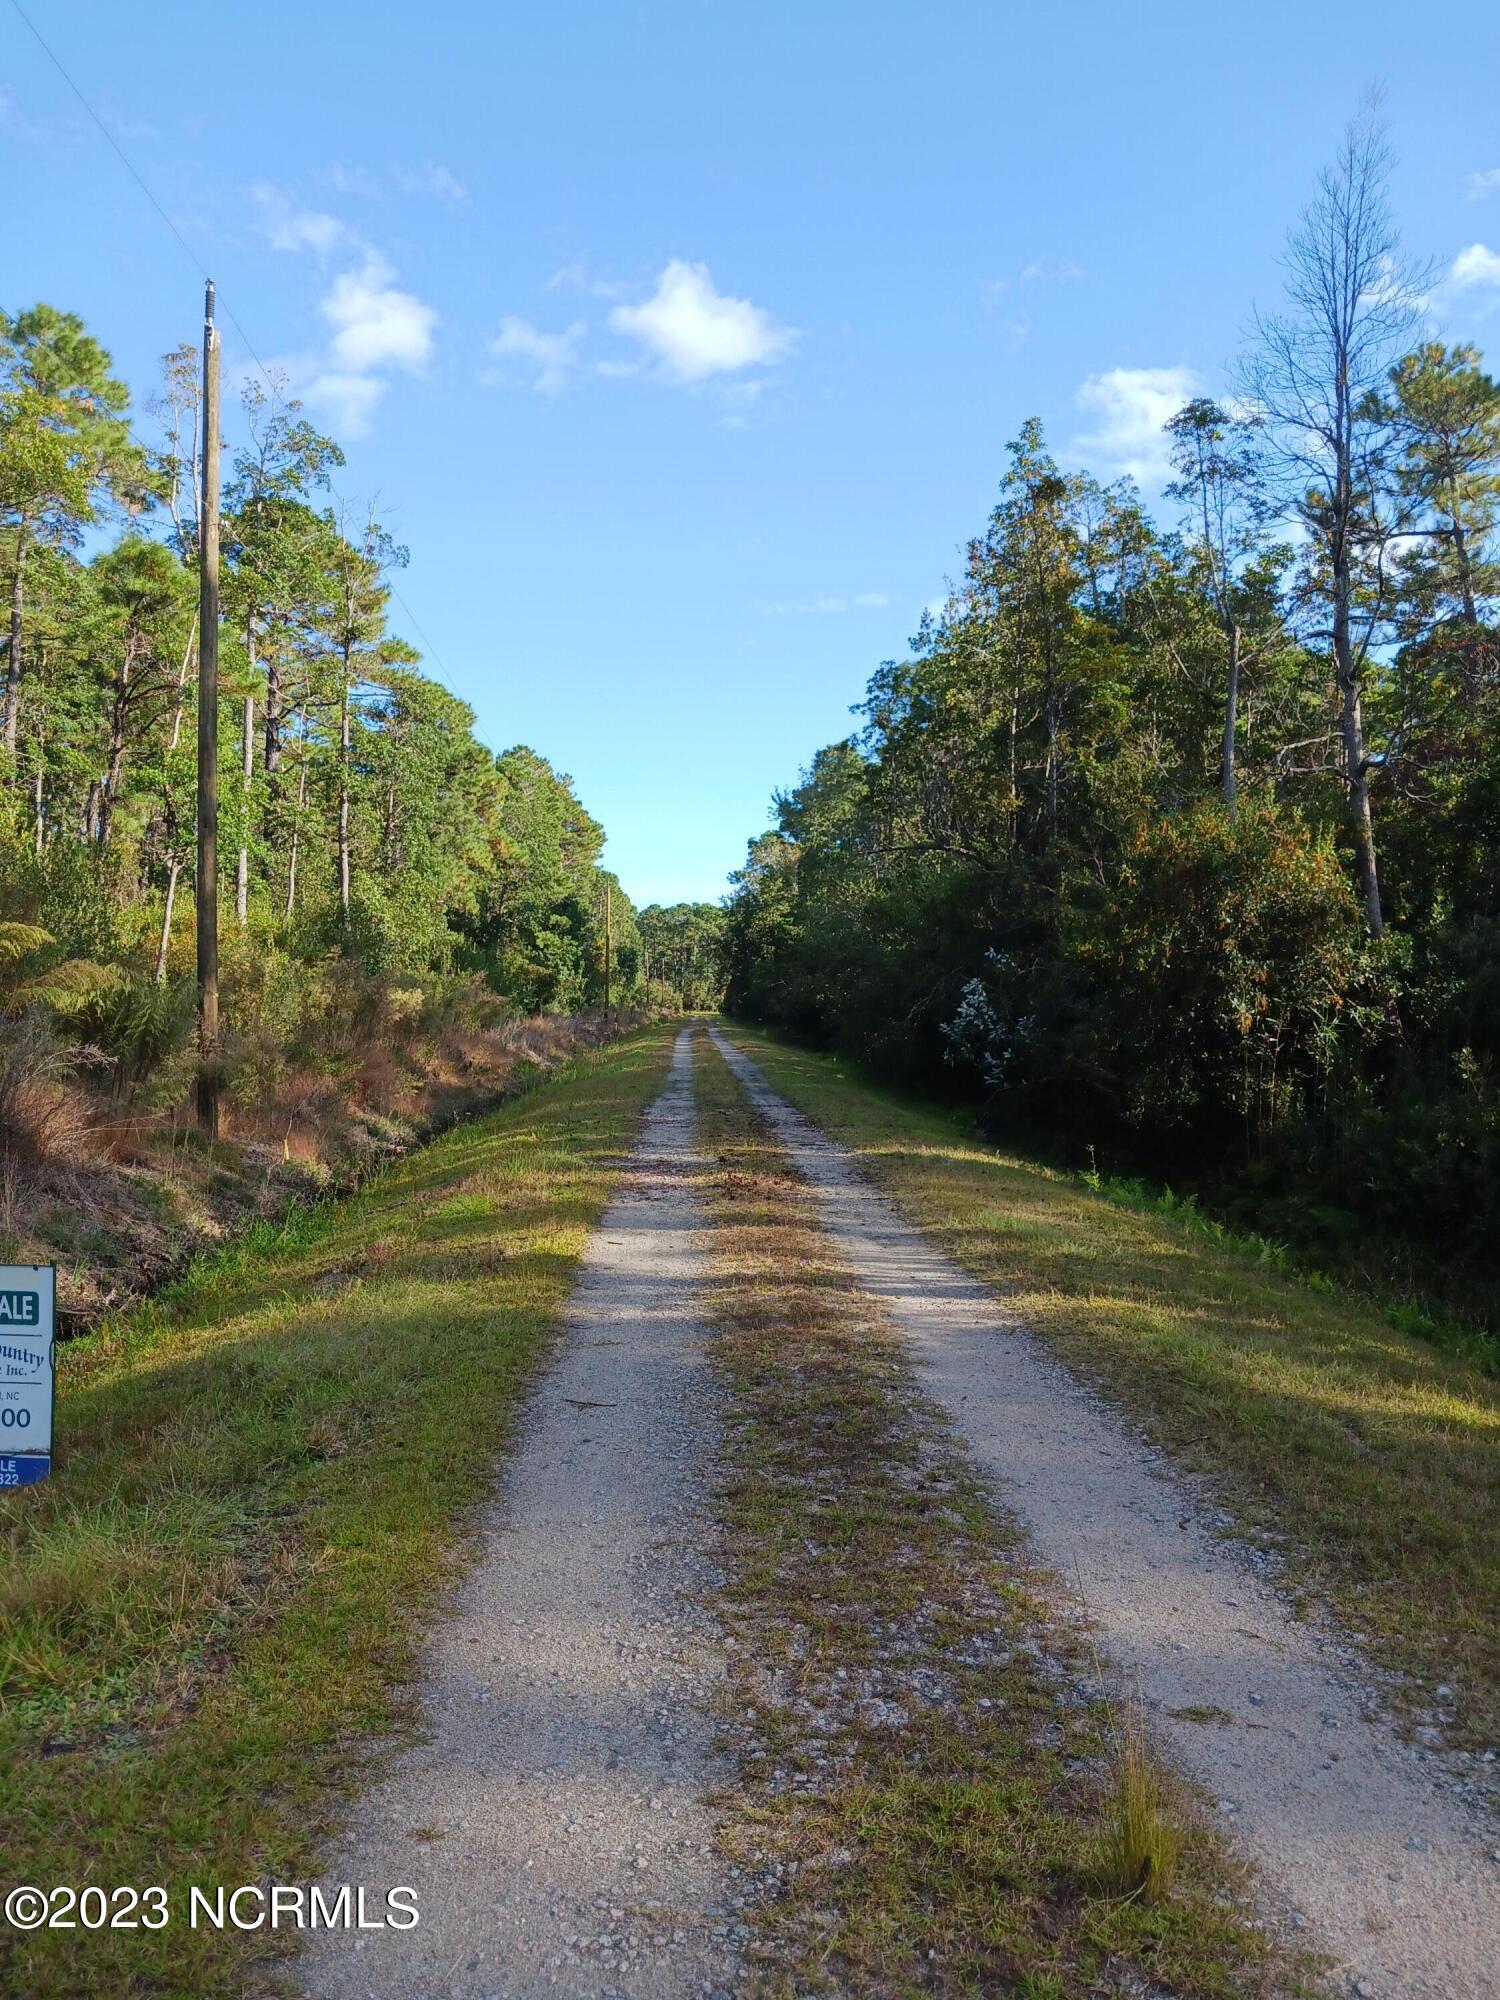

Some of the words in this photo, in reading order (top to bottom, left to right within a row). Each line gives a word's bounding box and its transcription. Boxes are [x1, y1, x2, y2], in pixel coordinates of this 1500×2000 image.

[0, 1345, 44, 1373] untry
[6, 1364, 27, 1376] Inc.
[6, 1391, 20, 1400] NC
